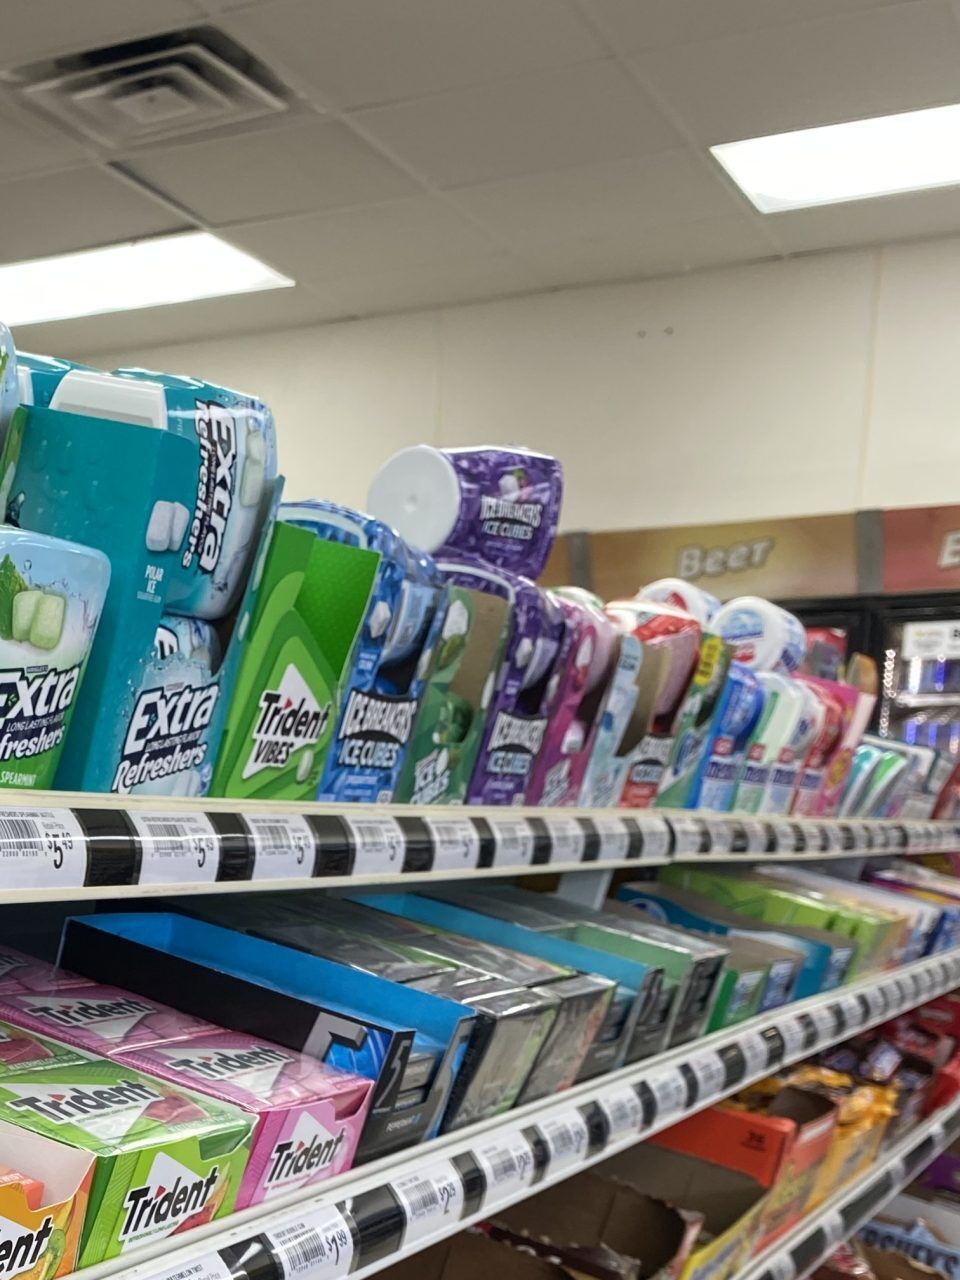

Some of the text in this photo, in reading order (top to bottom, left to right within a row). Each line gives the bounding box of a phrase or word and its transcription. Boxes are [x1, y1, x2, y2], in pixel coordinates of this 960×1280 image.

[203, 403, 238, 573] Extra
[144, 565, 163, 582] POLAR
[678, 537, 773, 579] Beer
[123, 684, 220, 756] Extra
[257, 693, 331, 739] Trident
[112, 743, 208, 794] Refreshers
[254, 740, 294, 764] VIBES
[0, 771, 37, 786] SPEARMINT
[33, 999, 153, 1026] Trident
[173, 1046, 286, 1079] Trident
[11, 1080, 159, 1122] Trident
[268, 1131, 343, 1183] Trident
[123, 1167, 218, 1235] Trident
